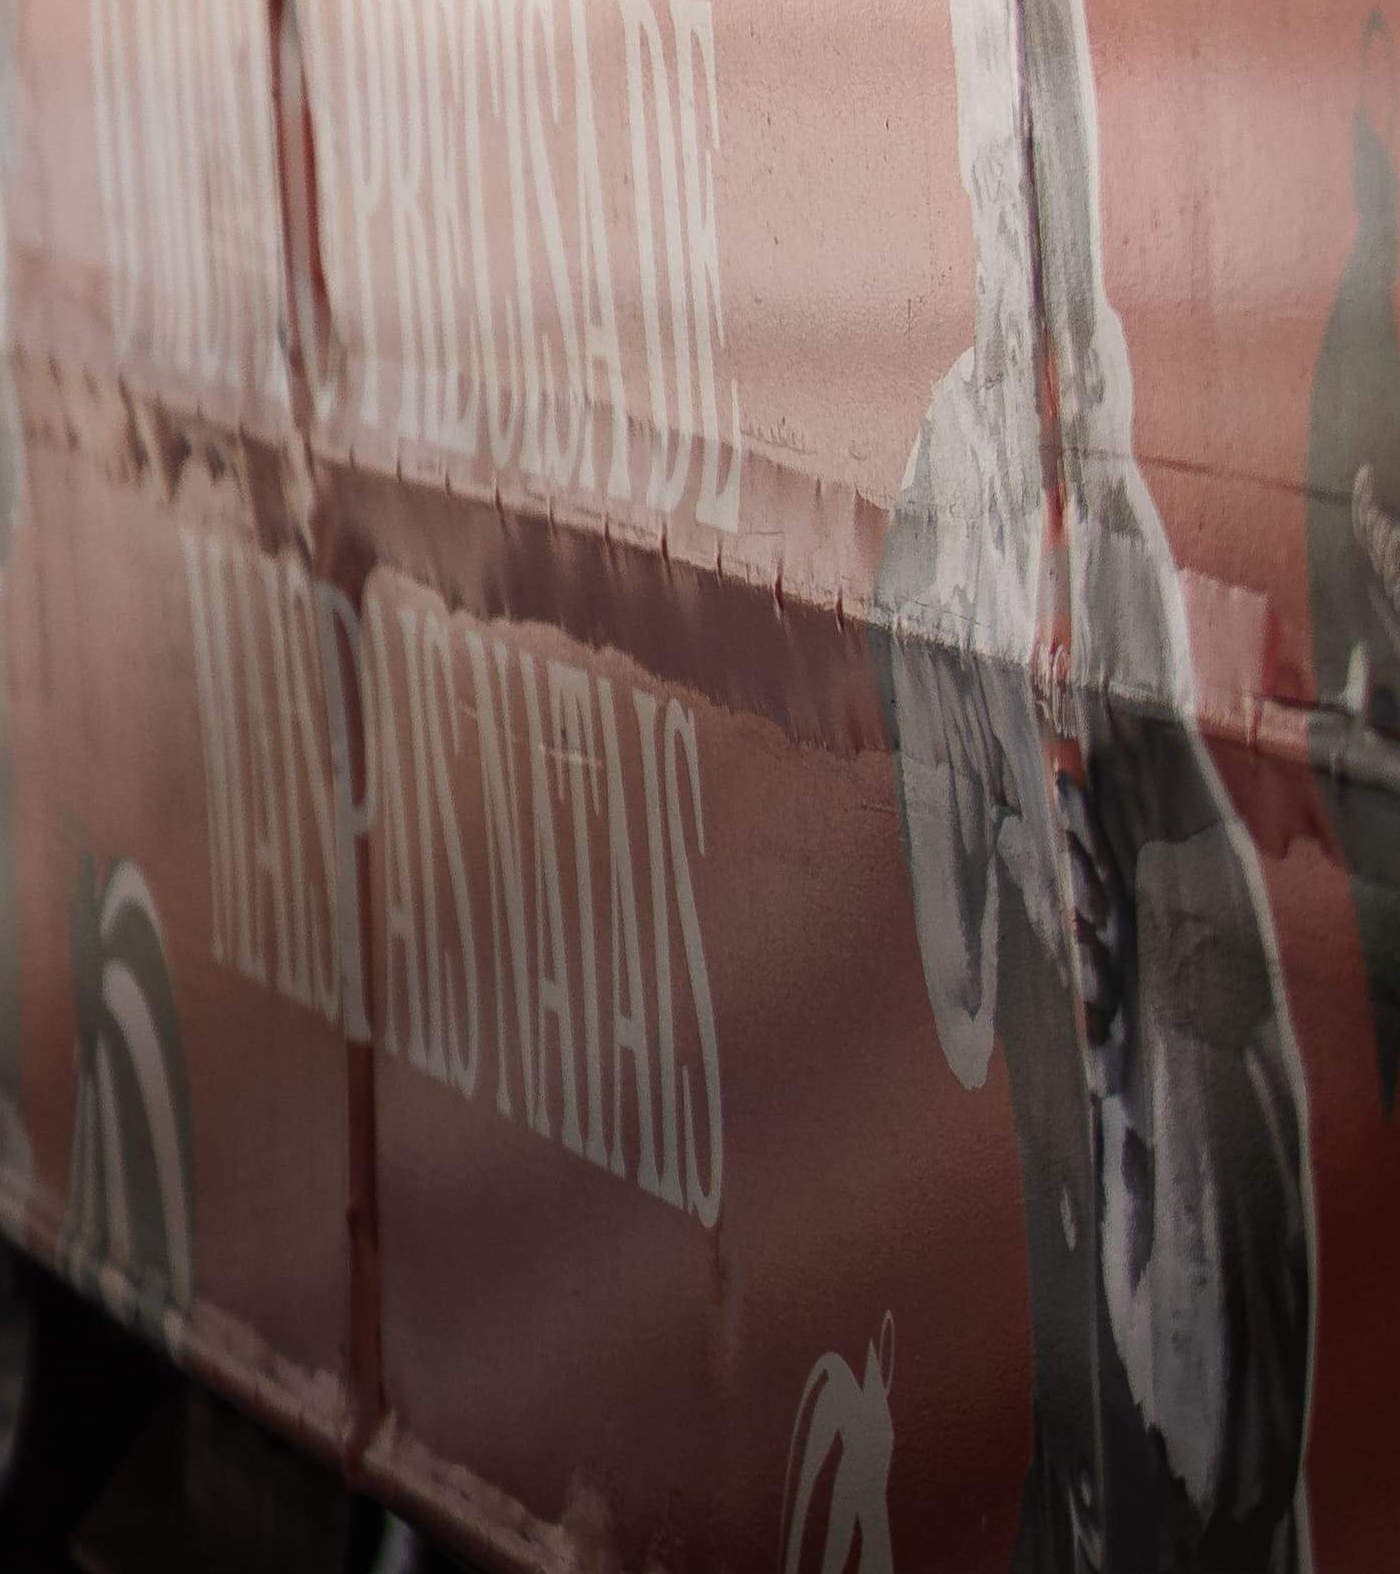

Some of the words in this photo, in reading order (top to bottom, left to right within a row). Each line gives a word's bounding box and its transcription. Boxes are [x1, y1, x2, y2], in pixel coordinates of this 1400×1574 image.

[179, 525, 343, 1025] MAIS
[318, 581, 483, 1100] PAIS
[464, 629, 724, 1229] NATAIS
